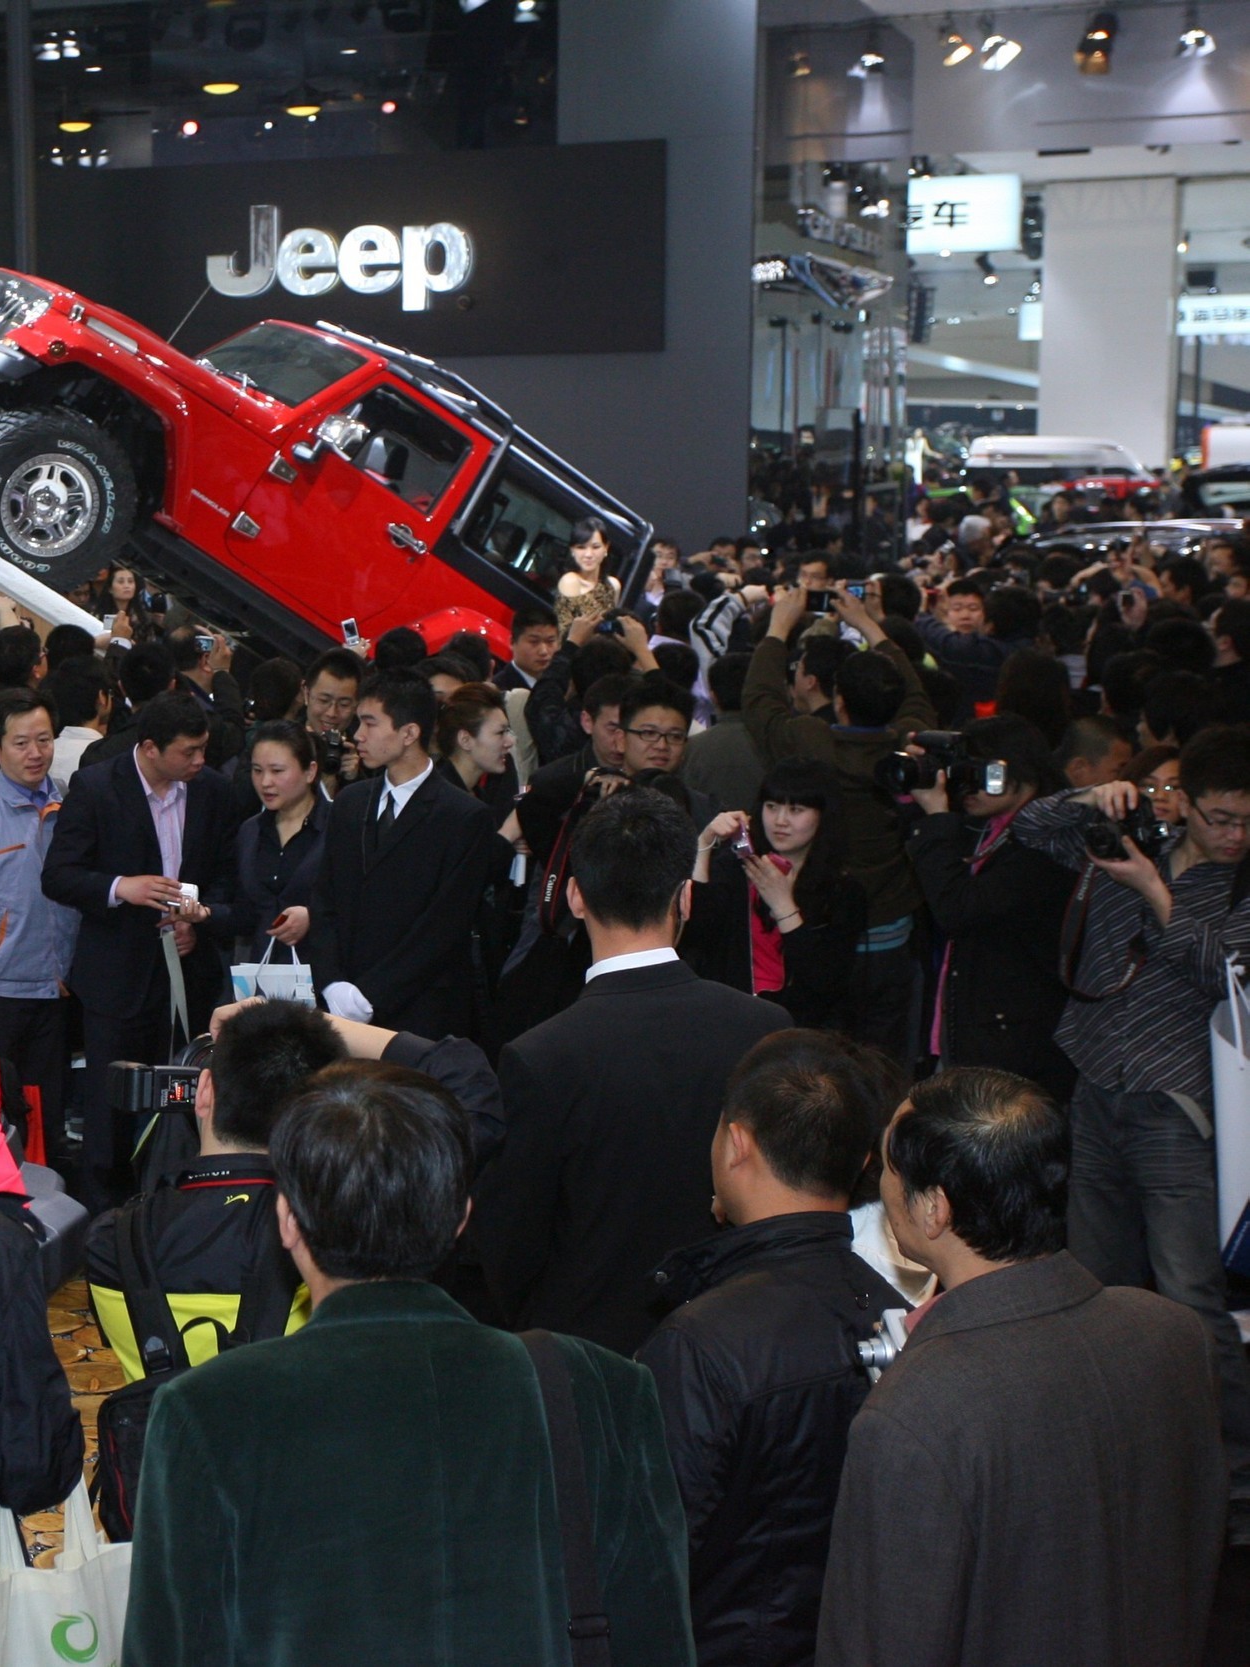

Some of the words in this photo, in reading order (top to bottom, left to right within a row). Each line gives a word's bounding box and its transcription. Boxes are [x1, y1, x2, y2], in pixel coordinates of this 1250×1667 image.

[206, 204, 472, 311] Jeep
[57, 439, 116, 535] WRANGLER
[544, 874, 557, 902] Canon
